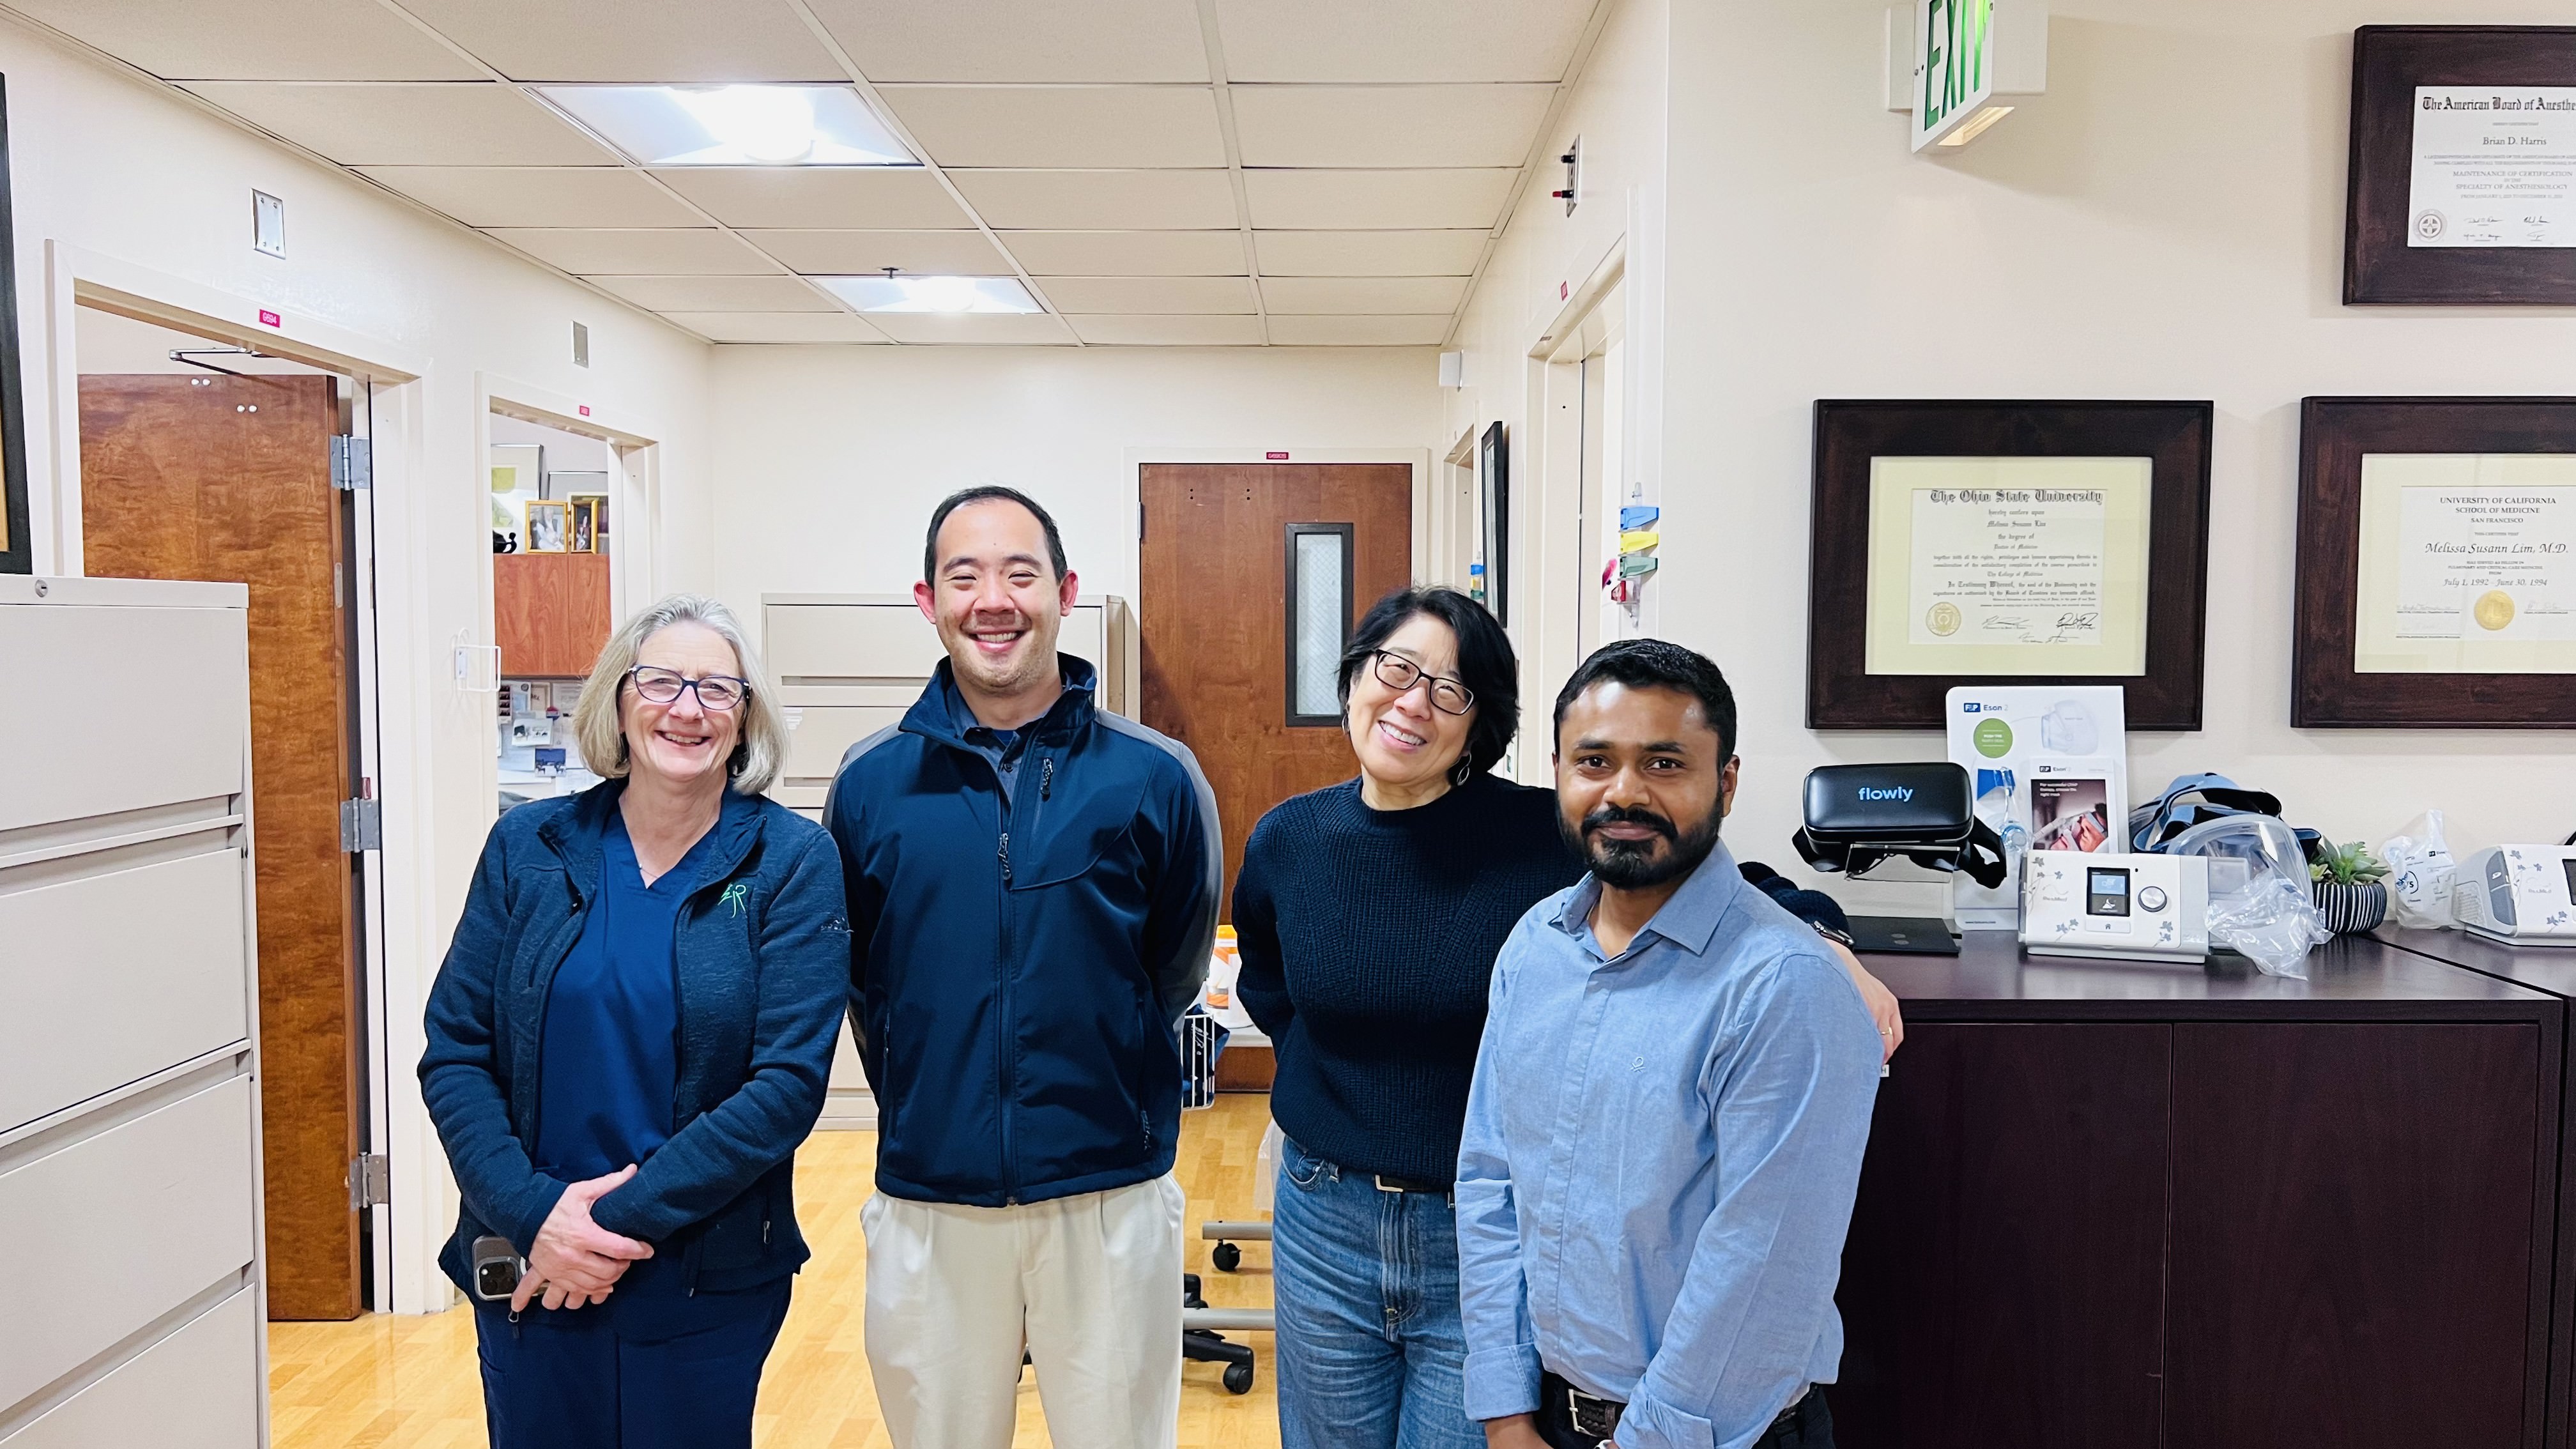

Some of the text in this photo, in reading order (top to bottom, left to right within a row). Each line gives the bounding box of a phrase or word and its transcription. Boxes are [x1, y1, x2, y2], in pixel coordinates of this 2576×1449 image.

[1924, 0, 1989, 132] EXIT
[2423, 96, 2442, 111] The
[2443, 96, 2489, 111] American
[2492, 96, 2521, 111] Board
[2524, 99, 2534, 111] of
[2483, 137, 2505, 145] Brian
[2520, 137, 2547, 145] Harris
[1931, 489, 2103, 505] The Ohio State University
[2425, 542, 2568, 554] Melissa Susann Lim, M.D.
[2443, 578, 2460, 588] July
[2495, 578, 2514, 587] June
[1859, 786, 1913, 802] flowly
